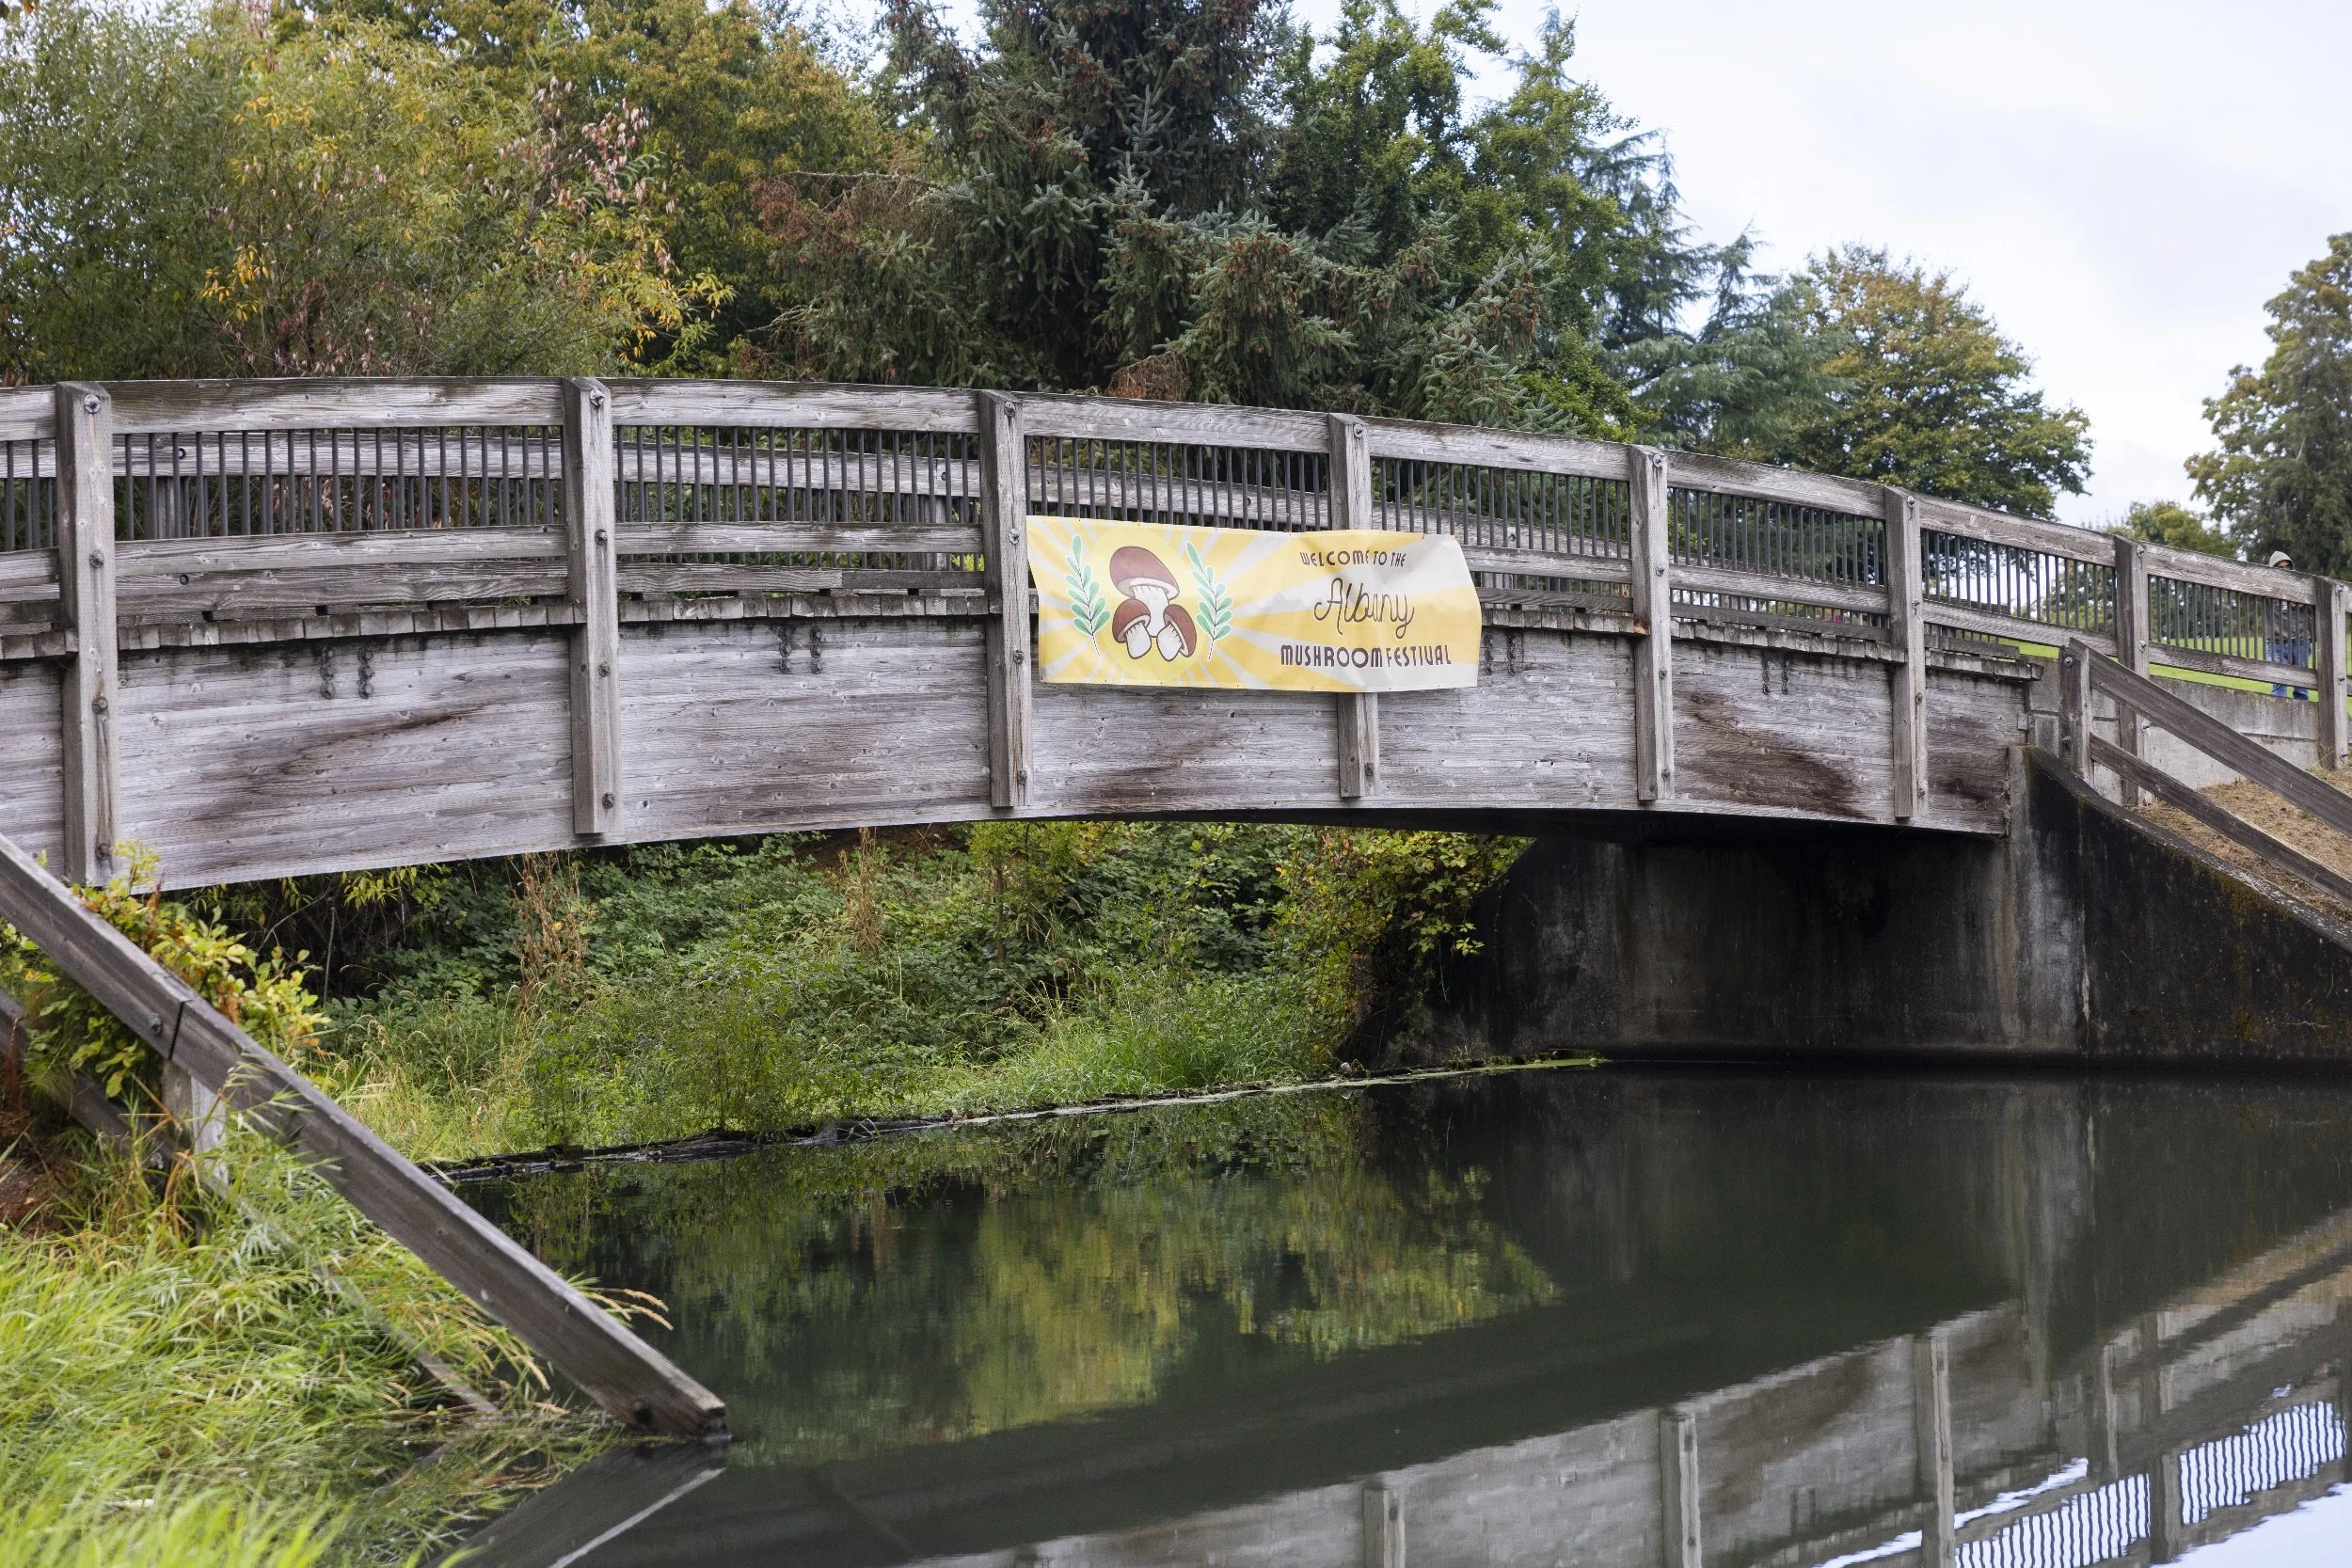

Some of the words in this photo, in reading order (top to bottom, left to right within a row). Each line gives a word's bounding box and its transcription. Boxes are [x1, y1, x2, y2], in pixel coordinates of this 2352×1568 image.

[1299, 549, 1369, 567] WELCOME
[1373, 550, 1388, 566] TO
[1391, 551, 1406, 567] THE
[1313, 577, 1415, 640] Albany
[1280, 644, 1383, 669] MUSHROOM
[1386, 644, 1452, 668] FESTIVAL
